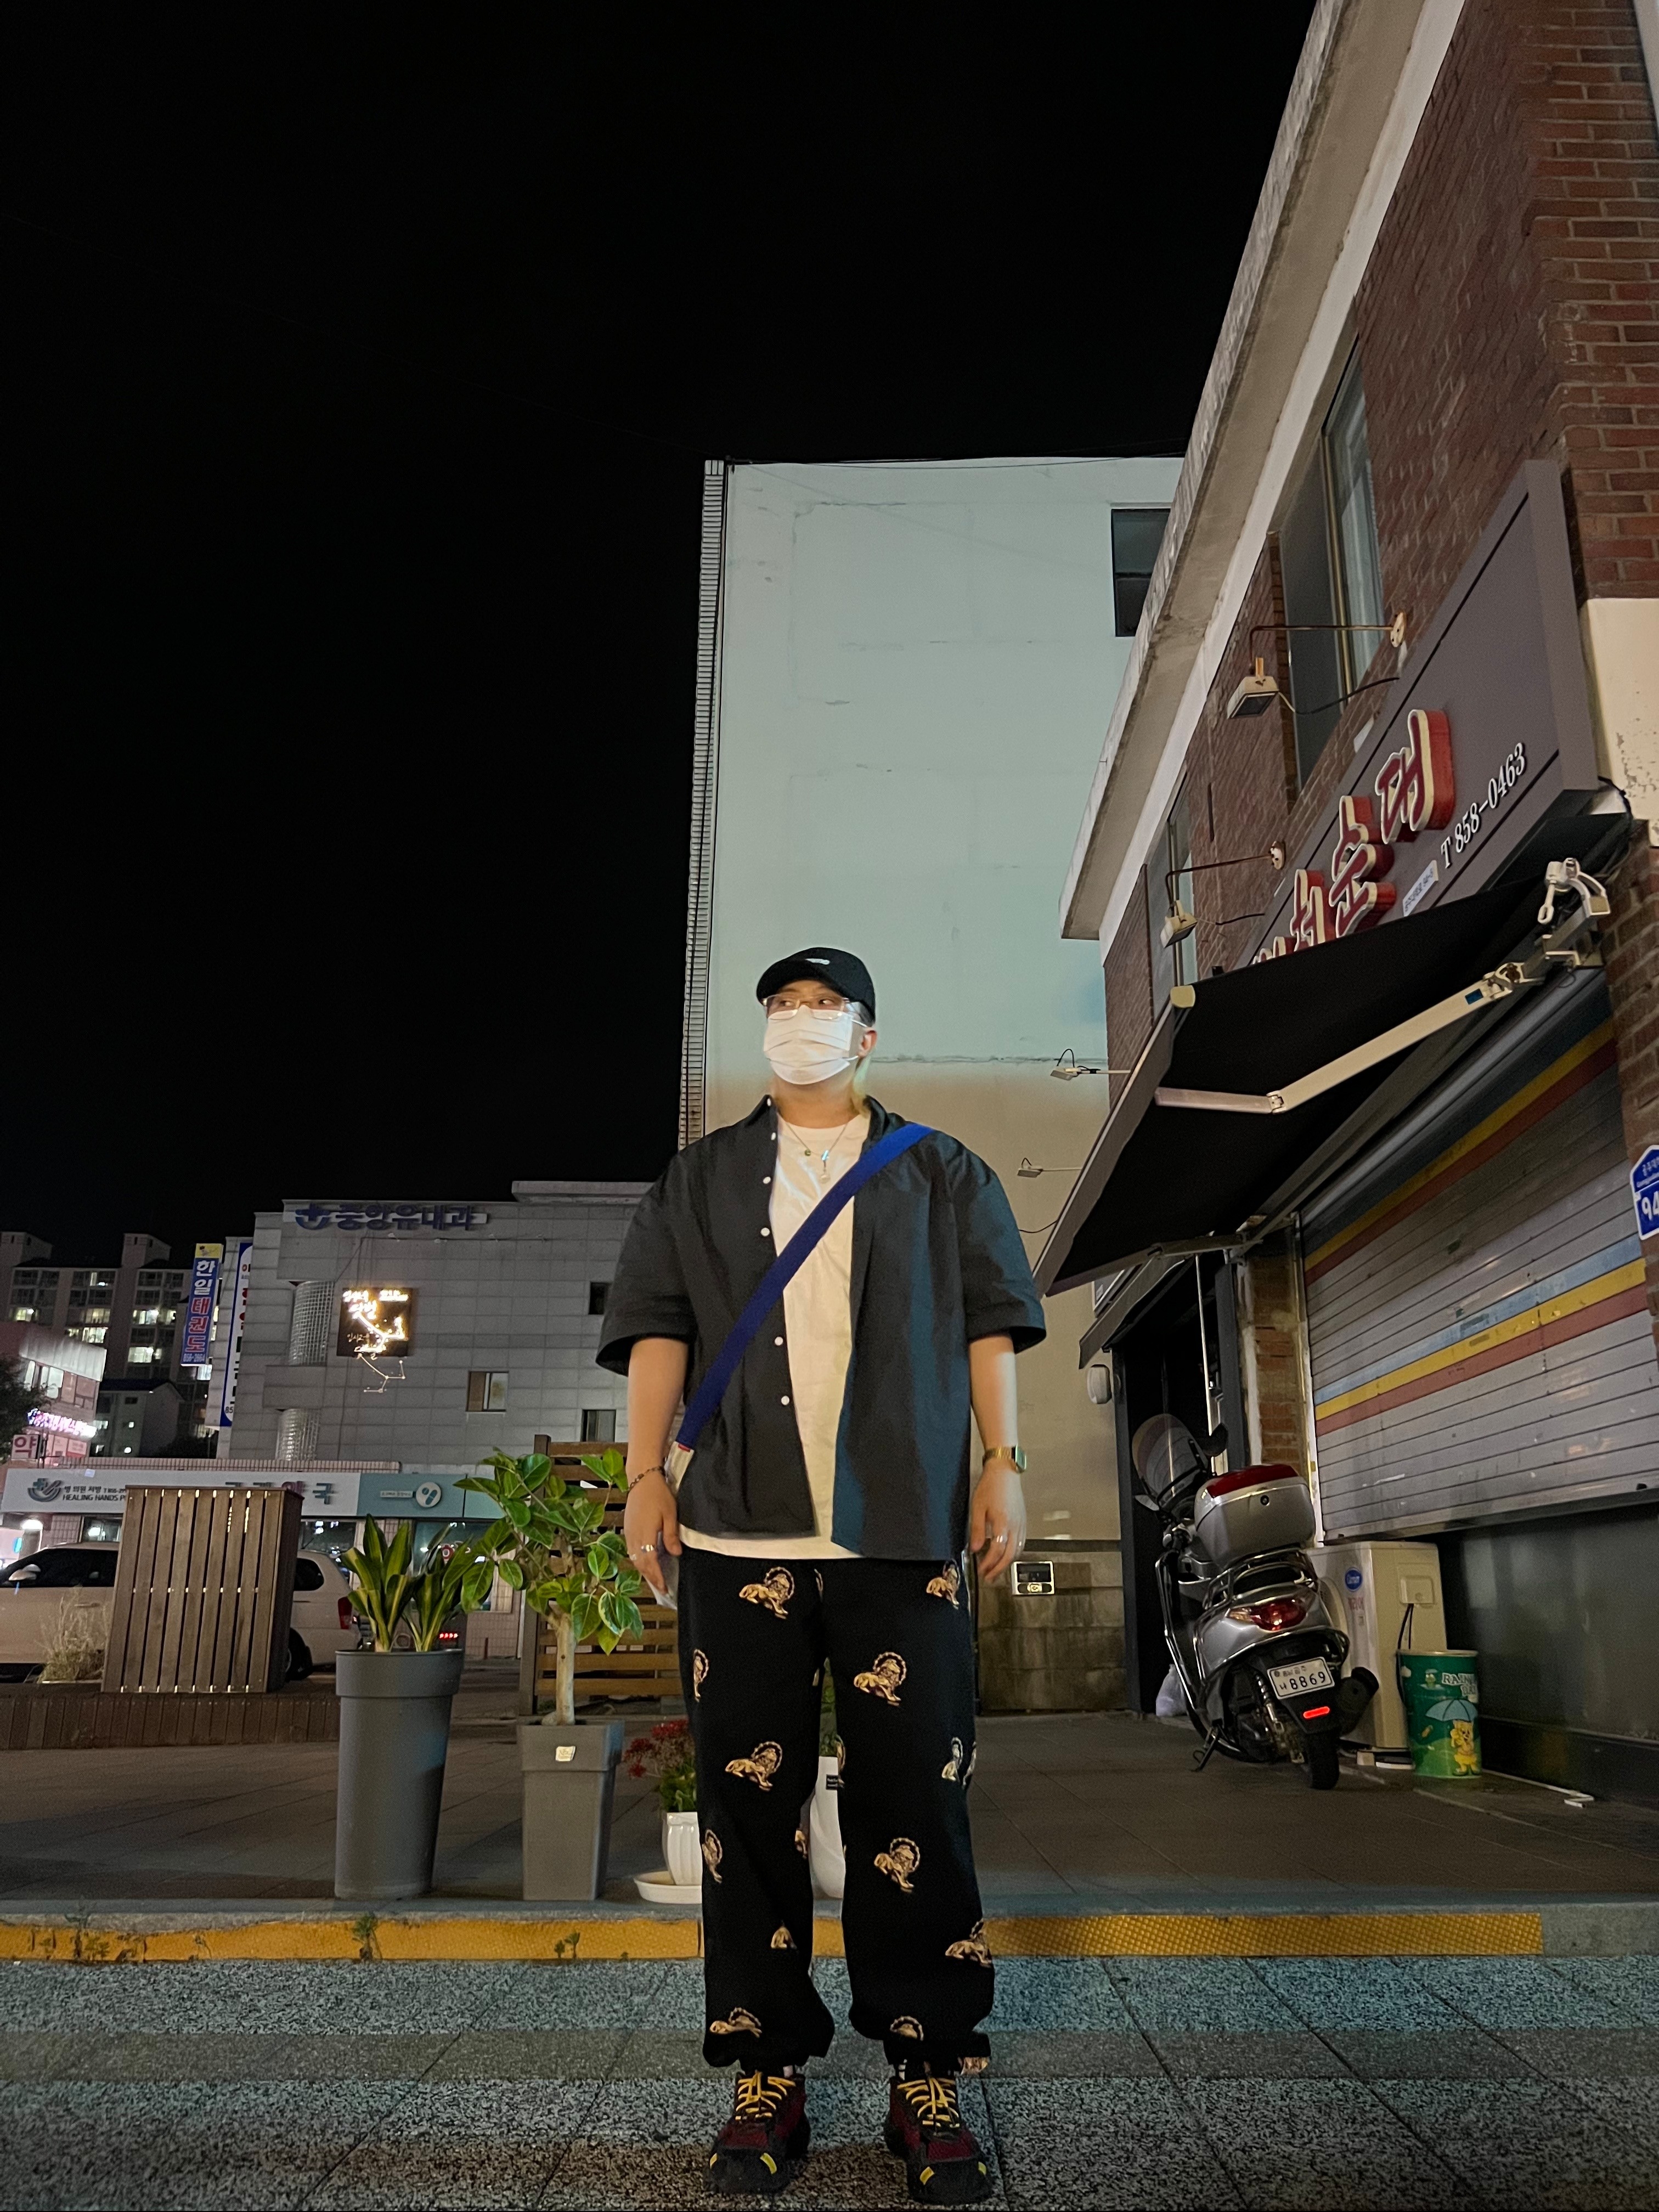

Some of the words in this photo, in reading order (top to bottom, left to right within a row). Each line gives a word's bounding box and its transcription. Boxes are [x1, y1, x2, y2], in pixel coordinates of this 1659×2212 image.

[1441, 837, 1452, 868] T
[1455, 743, 1525, 853] 858-0463
[335, 1204, 475, 1231] 중앙유내과
[14, 1436, 37, 1458] 약
[1289, 1671, 1325, 1690] 8869
